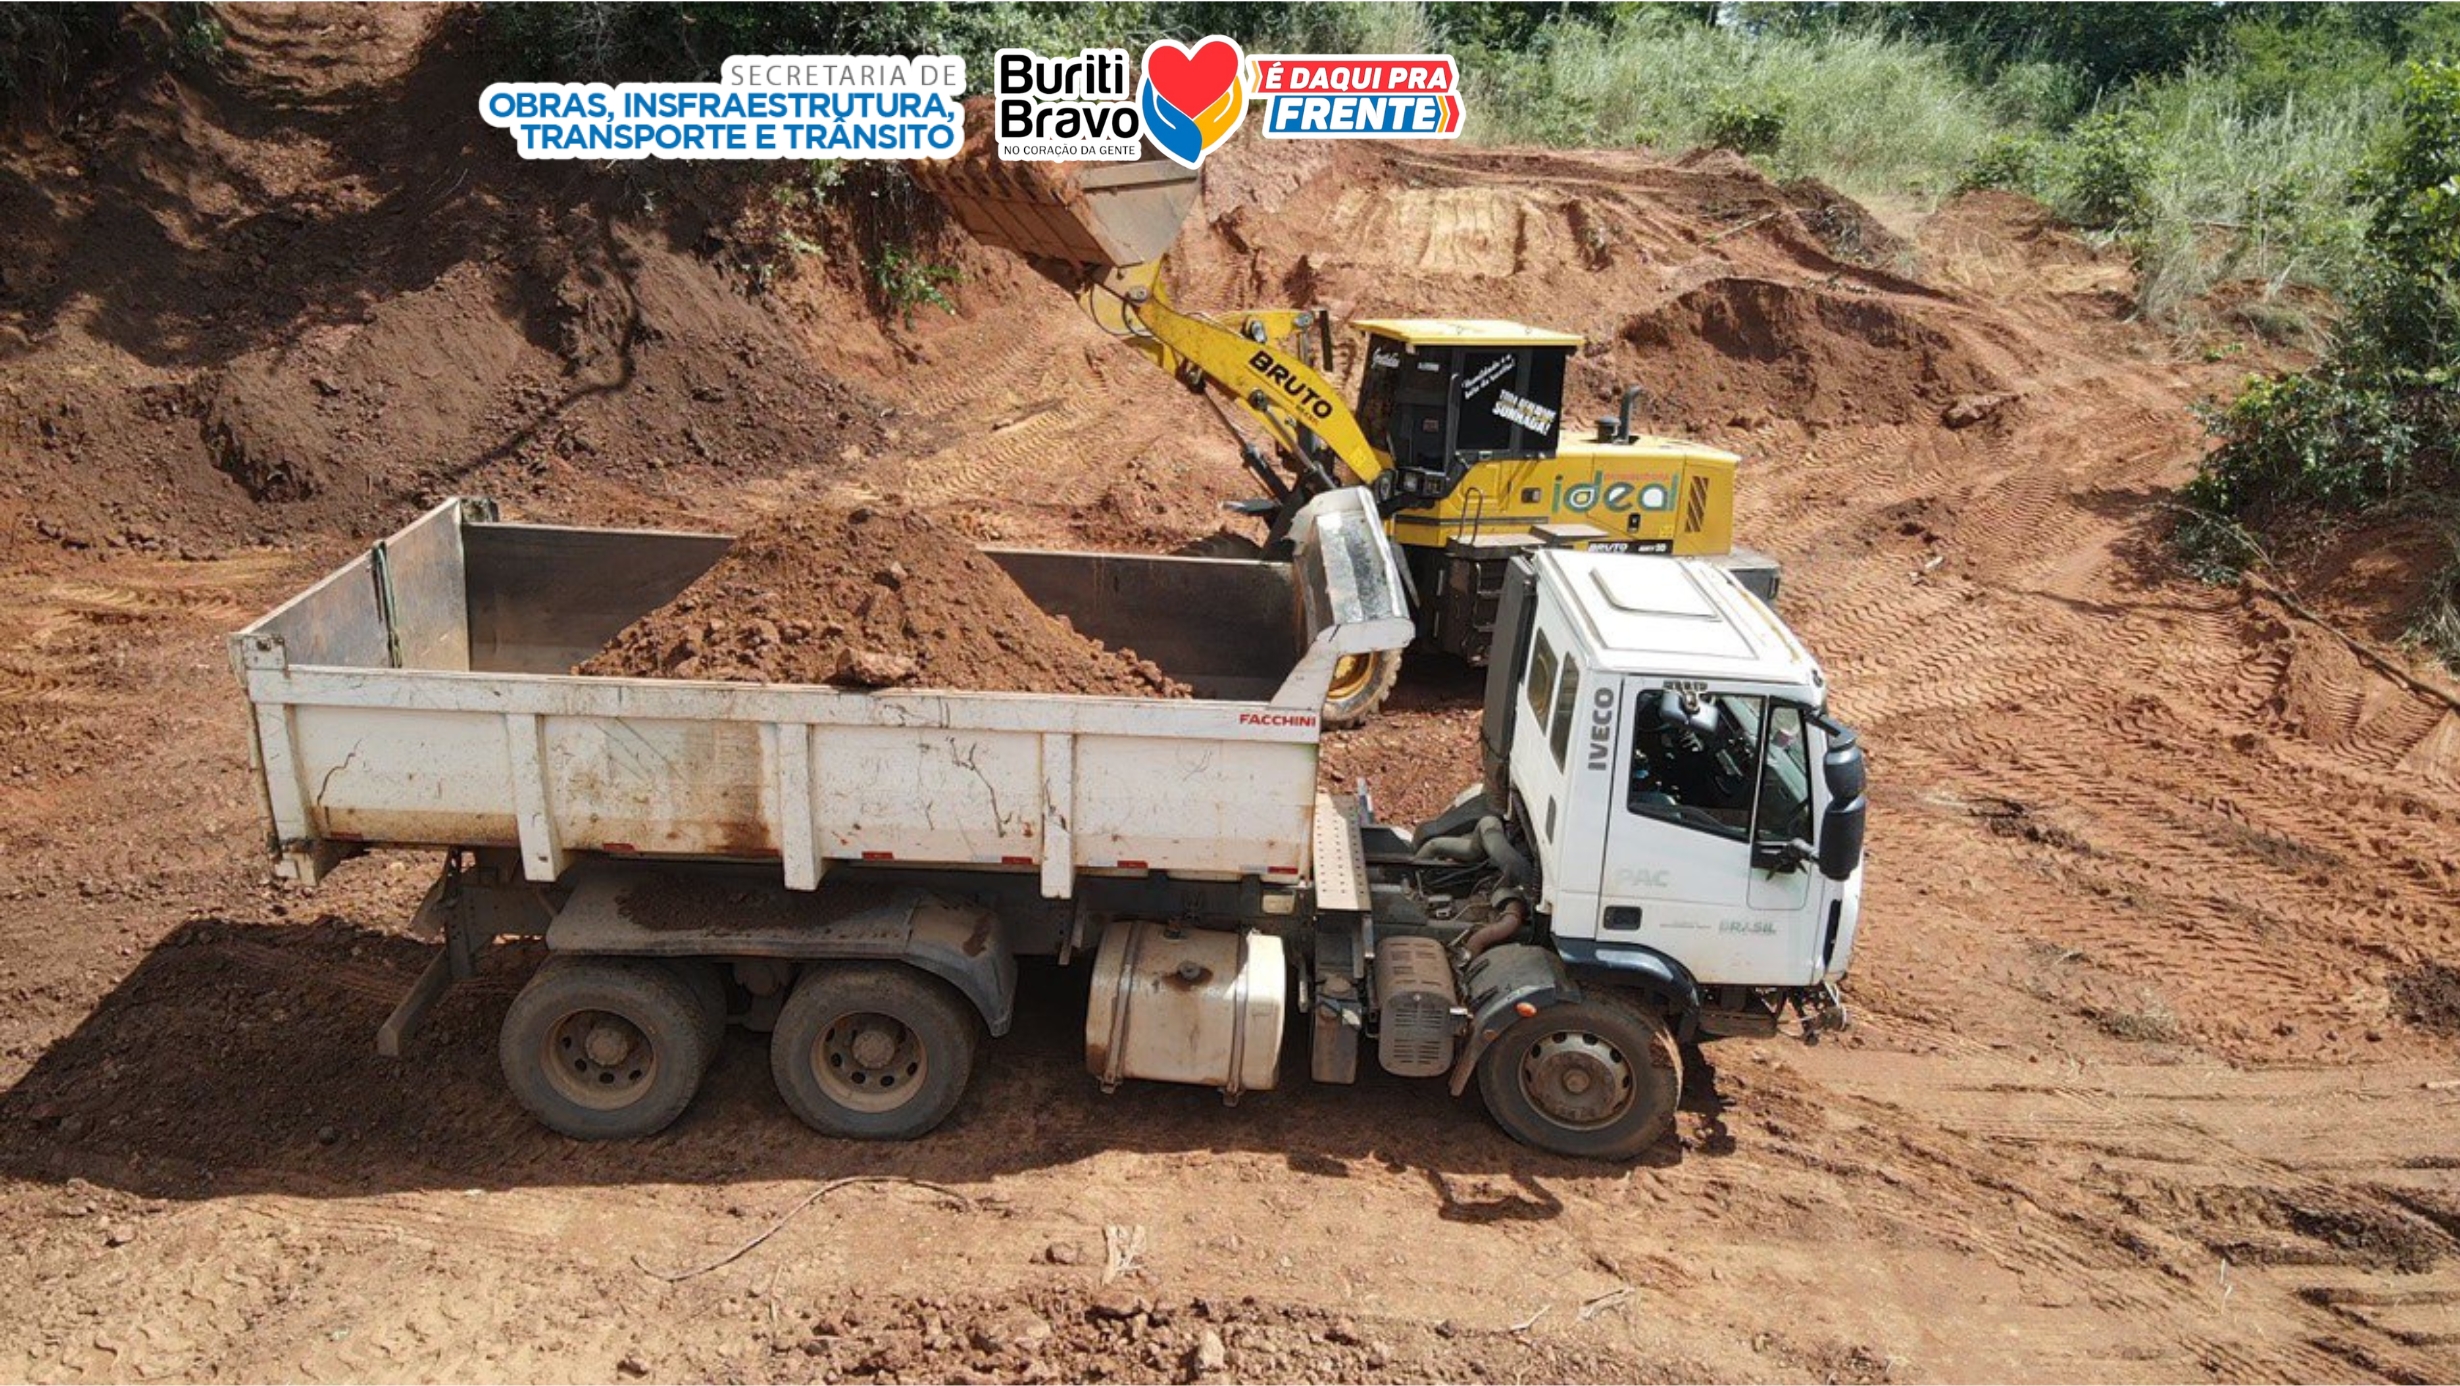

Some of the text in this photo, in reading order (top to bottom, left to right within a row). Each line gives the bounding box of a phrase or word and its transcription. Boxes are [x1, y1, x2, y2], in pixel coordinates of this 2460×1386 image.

[1248, 350, 1333, 419] BRUTO
[1551, 470, 1681, 514] ideal
[1239, 713, 1316, 727] FACCHINI
[1588, 687, 1615, 771] IVECO
